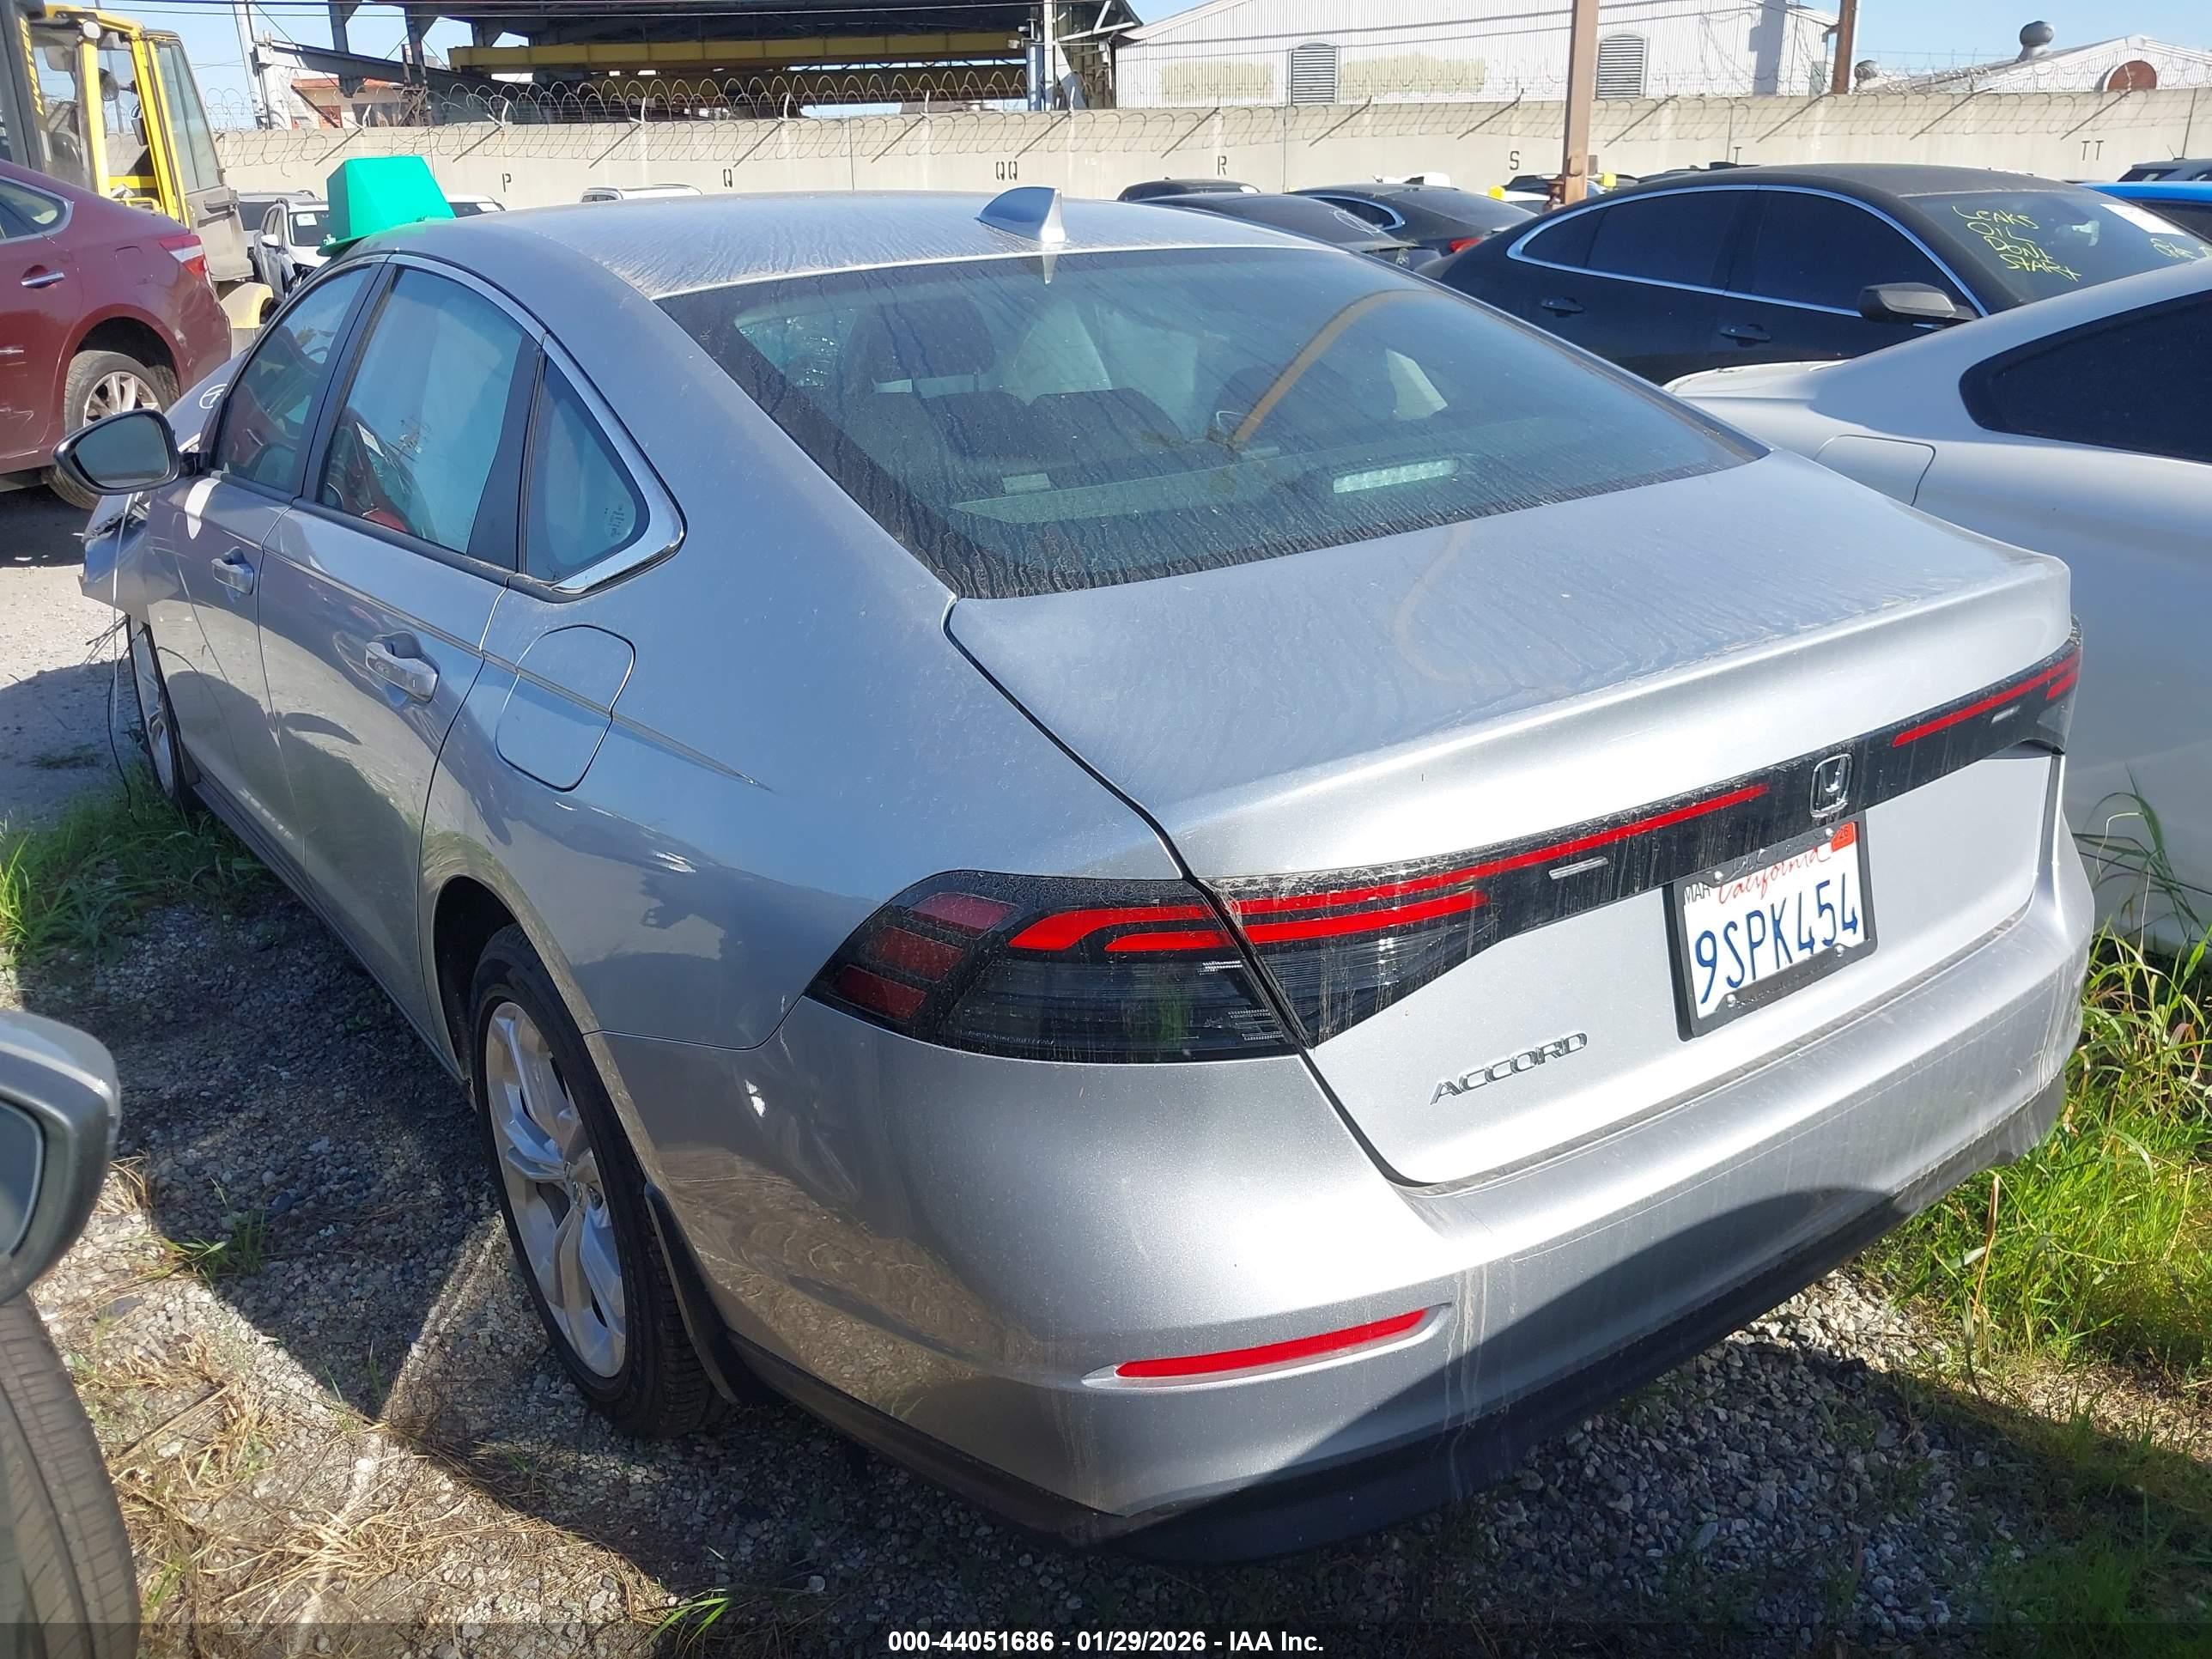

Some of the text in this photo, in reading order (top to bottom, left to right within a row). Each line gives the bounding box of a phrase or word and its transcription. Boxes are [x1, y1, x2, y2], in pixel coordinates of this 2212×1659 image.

[19, 16, 45, 116] HYSTER
[995, 161, 1018, 181] QQ
[1217, 155, 1227, 176] R
[1510, 150, 1520, 171] S
[501, 173, 512, 193] P
[722, 168, 733, 188] Q
[1718, 846, 1832, 904] California
[1694, 872, 1858, 1005] 9SPK454
[1430, 1032, 1588, 1105] ACCORD
